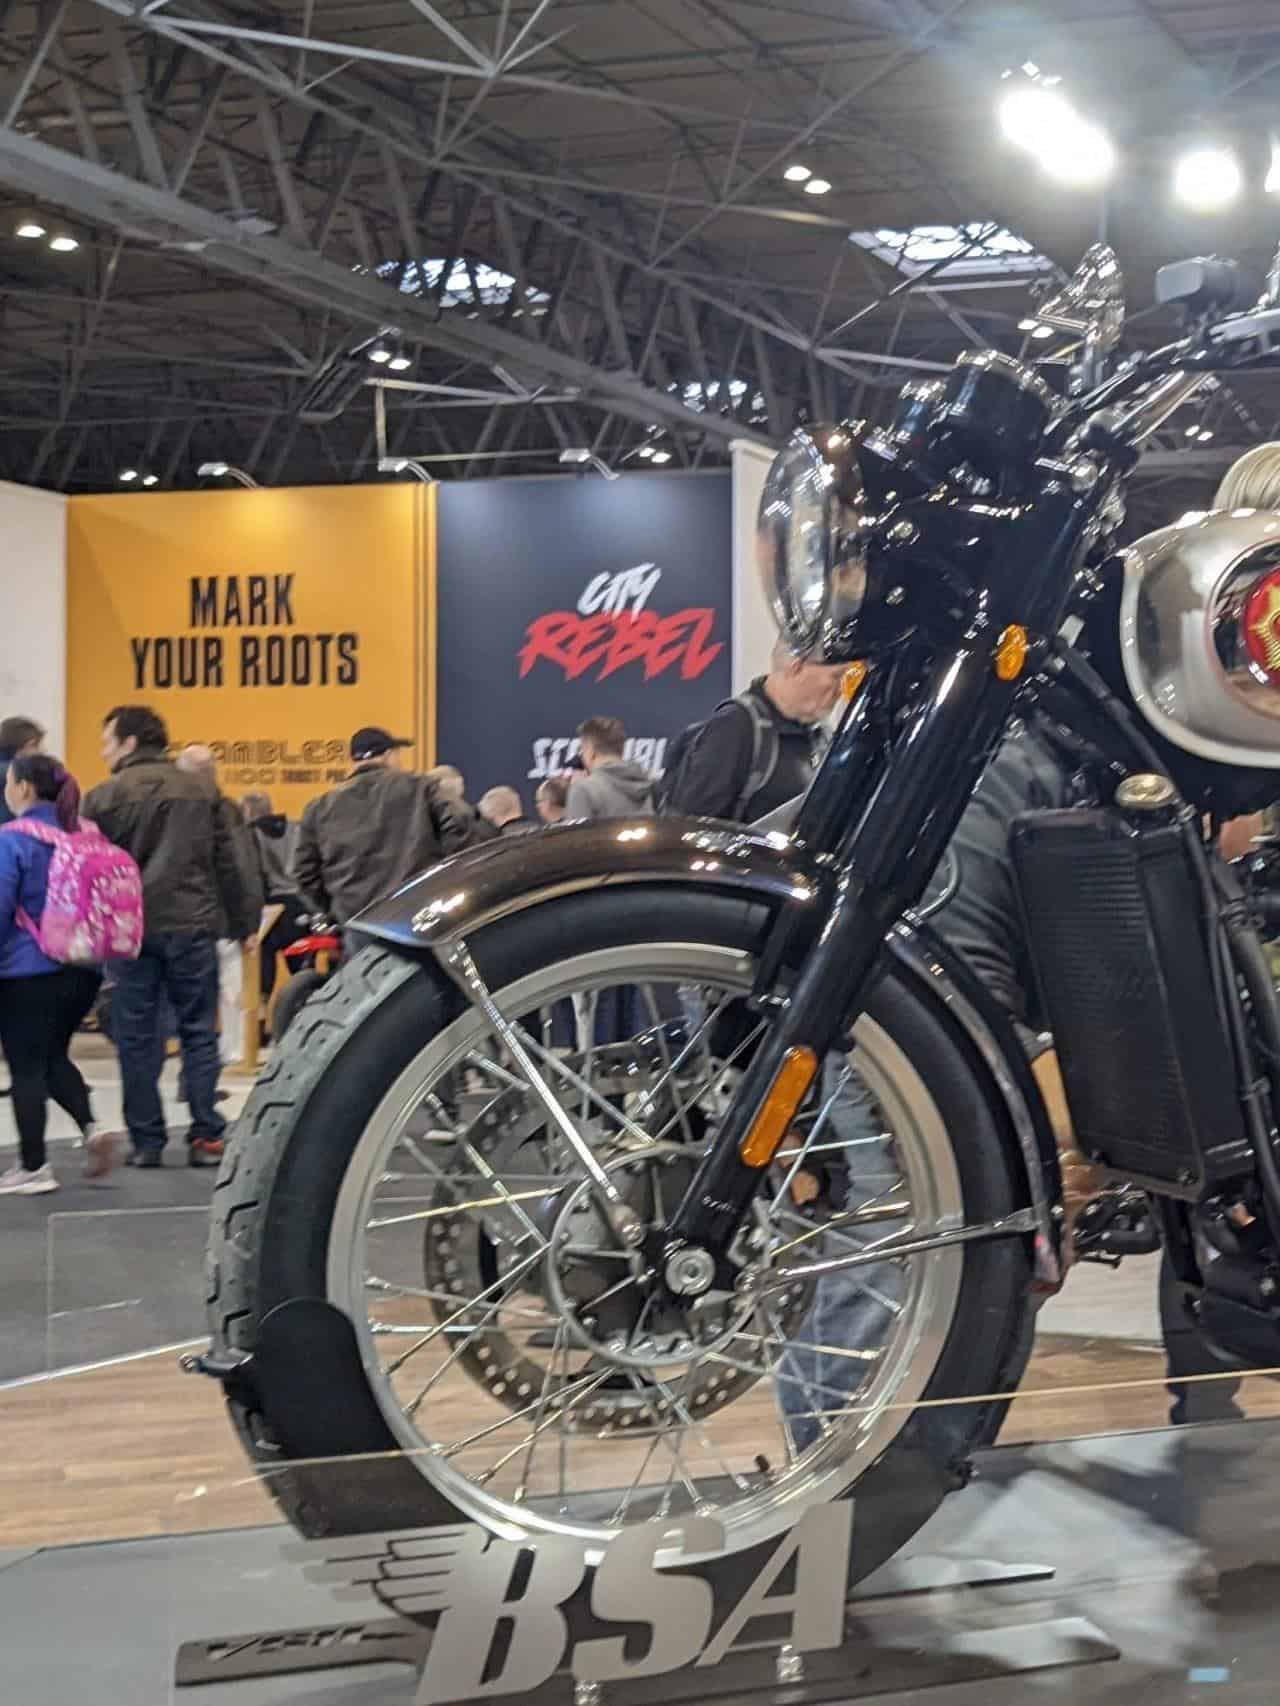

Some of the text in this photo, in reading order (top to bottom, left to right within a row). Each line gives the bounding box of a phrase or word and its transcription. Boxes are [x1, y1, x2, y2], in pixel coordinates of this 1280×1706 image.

[190, 574, 295, 628] MARK
[577, 562, 662, 624] CITY
[131, 632, 358, 688] YOUR ROOTS
[517, 608, 725, 682] REBEL
[416, 1498, 855, 1706] BSA
